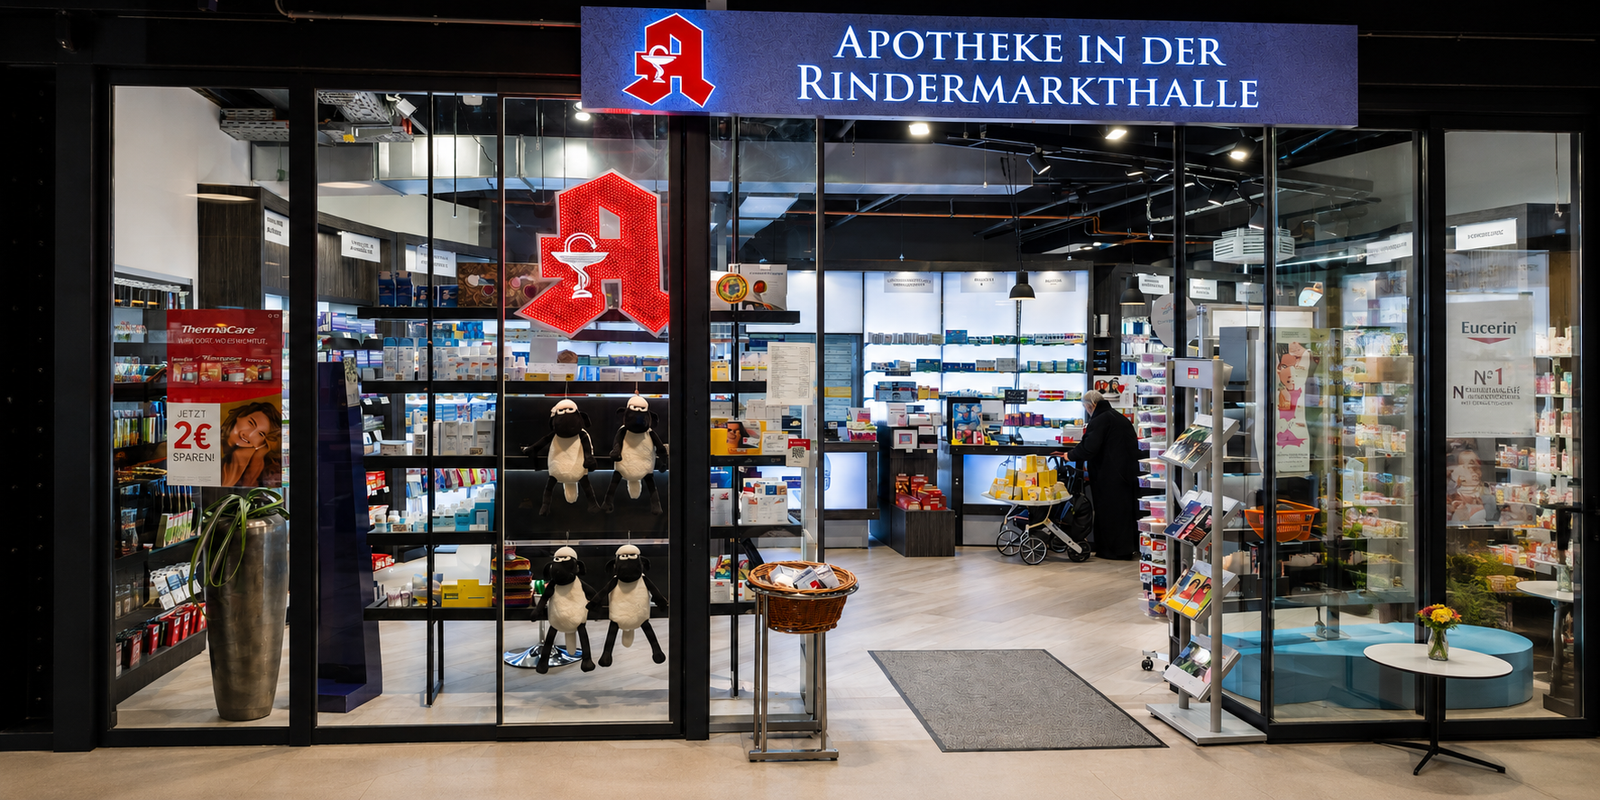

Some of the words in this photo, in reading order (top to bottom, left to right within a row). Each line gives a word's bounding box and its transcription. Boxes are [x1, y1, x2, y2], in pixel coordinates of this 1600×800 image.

[833, 24, 1063, 63] APOTHEKE
[1078, 34, 1126, 65] IN
[1142, 36, 1227, 66] DER
[797, 63, 1259, 108] RINDERMARKTHALLE
[181, 324, 256, 335] ThermaCare
[1461, 321, 1517, 334] Eucerin
[177, 409, 206, 418] JETZT
[173, 452, 215, 462] SPAREN!
